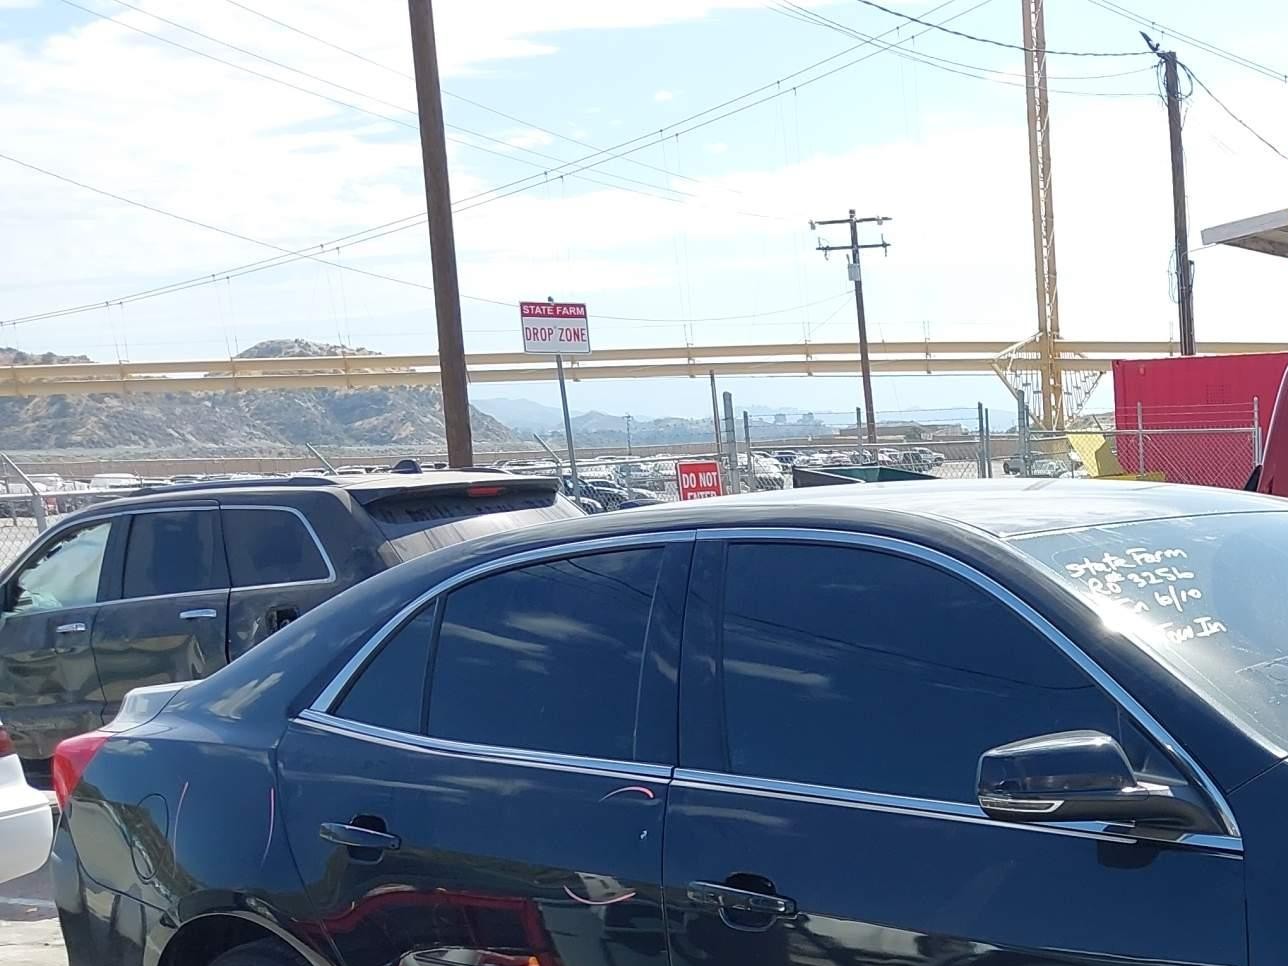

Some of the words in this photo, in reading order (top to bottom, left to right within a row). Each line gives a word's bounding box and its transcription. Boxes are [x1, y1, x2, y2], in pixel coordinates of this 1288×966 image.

[522, 305, 555, 315] STATE
[556, 306, 585, 316] FARM
[525, 326, 554, 342] DROP
[557, 327, 587, 343] ZONE
[682, 472, 697, 488] DO
[698, 471, 718, 488] NOT
[1065, 552, 1137, 578] State
[1126, 547, 1188, 566] Farm
